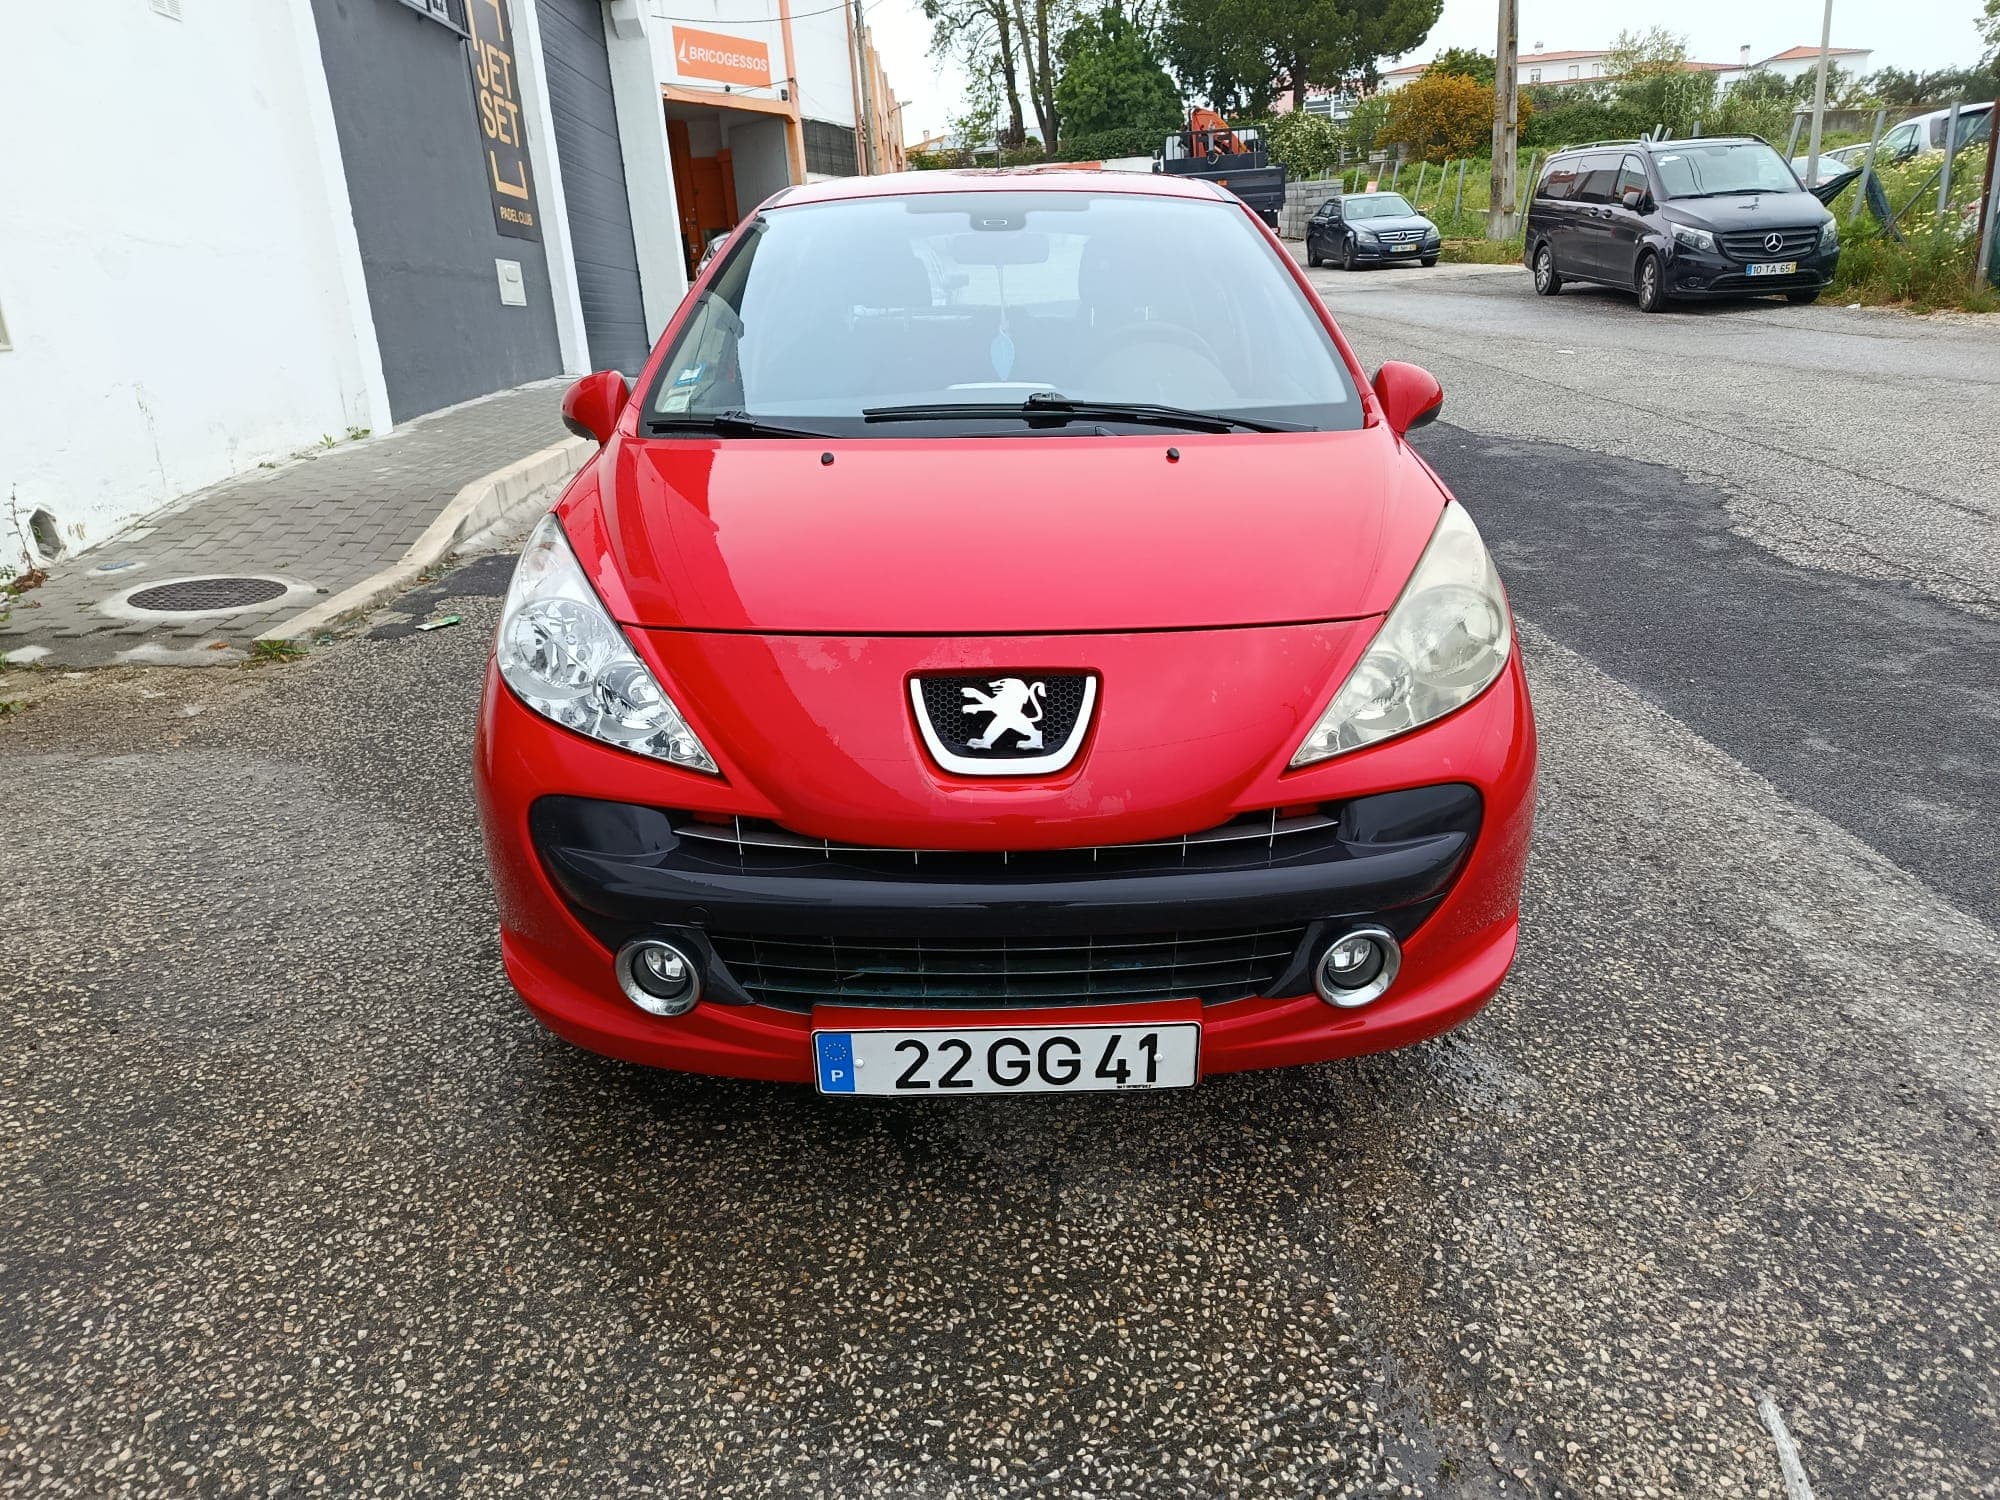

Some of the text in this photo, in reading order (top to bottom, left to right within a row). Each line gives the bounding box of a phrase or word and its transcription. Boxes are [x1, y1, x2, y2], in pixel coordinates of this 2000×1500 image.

[477, 40, 511, 99] JET
[689, 46, 768, 72] BRICOGESSOS
[480, 89, 519, 148] SET
[500, 205, 533, 226] PADEL CLUB
[1753, 265, 1761, 275] 10
[1766, 264, 1777, 273] TA
[895, 1033, 1160, 1089] 22 GG 41
[831, 1069, 844, 1082] P
